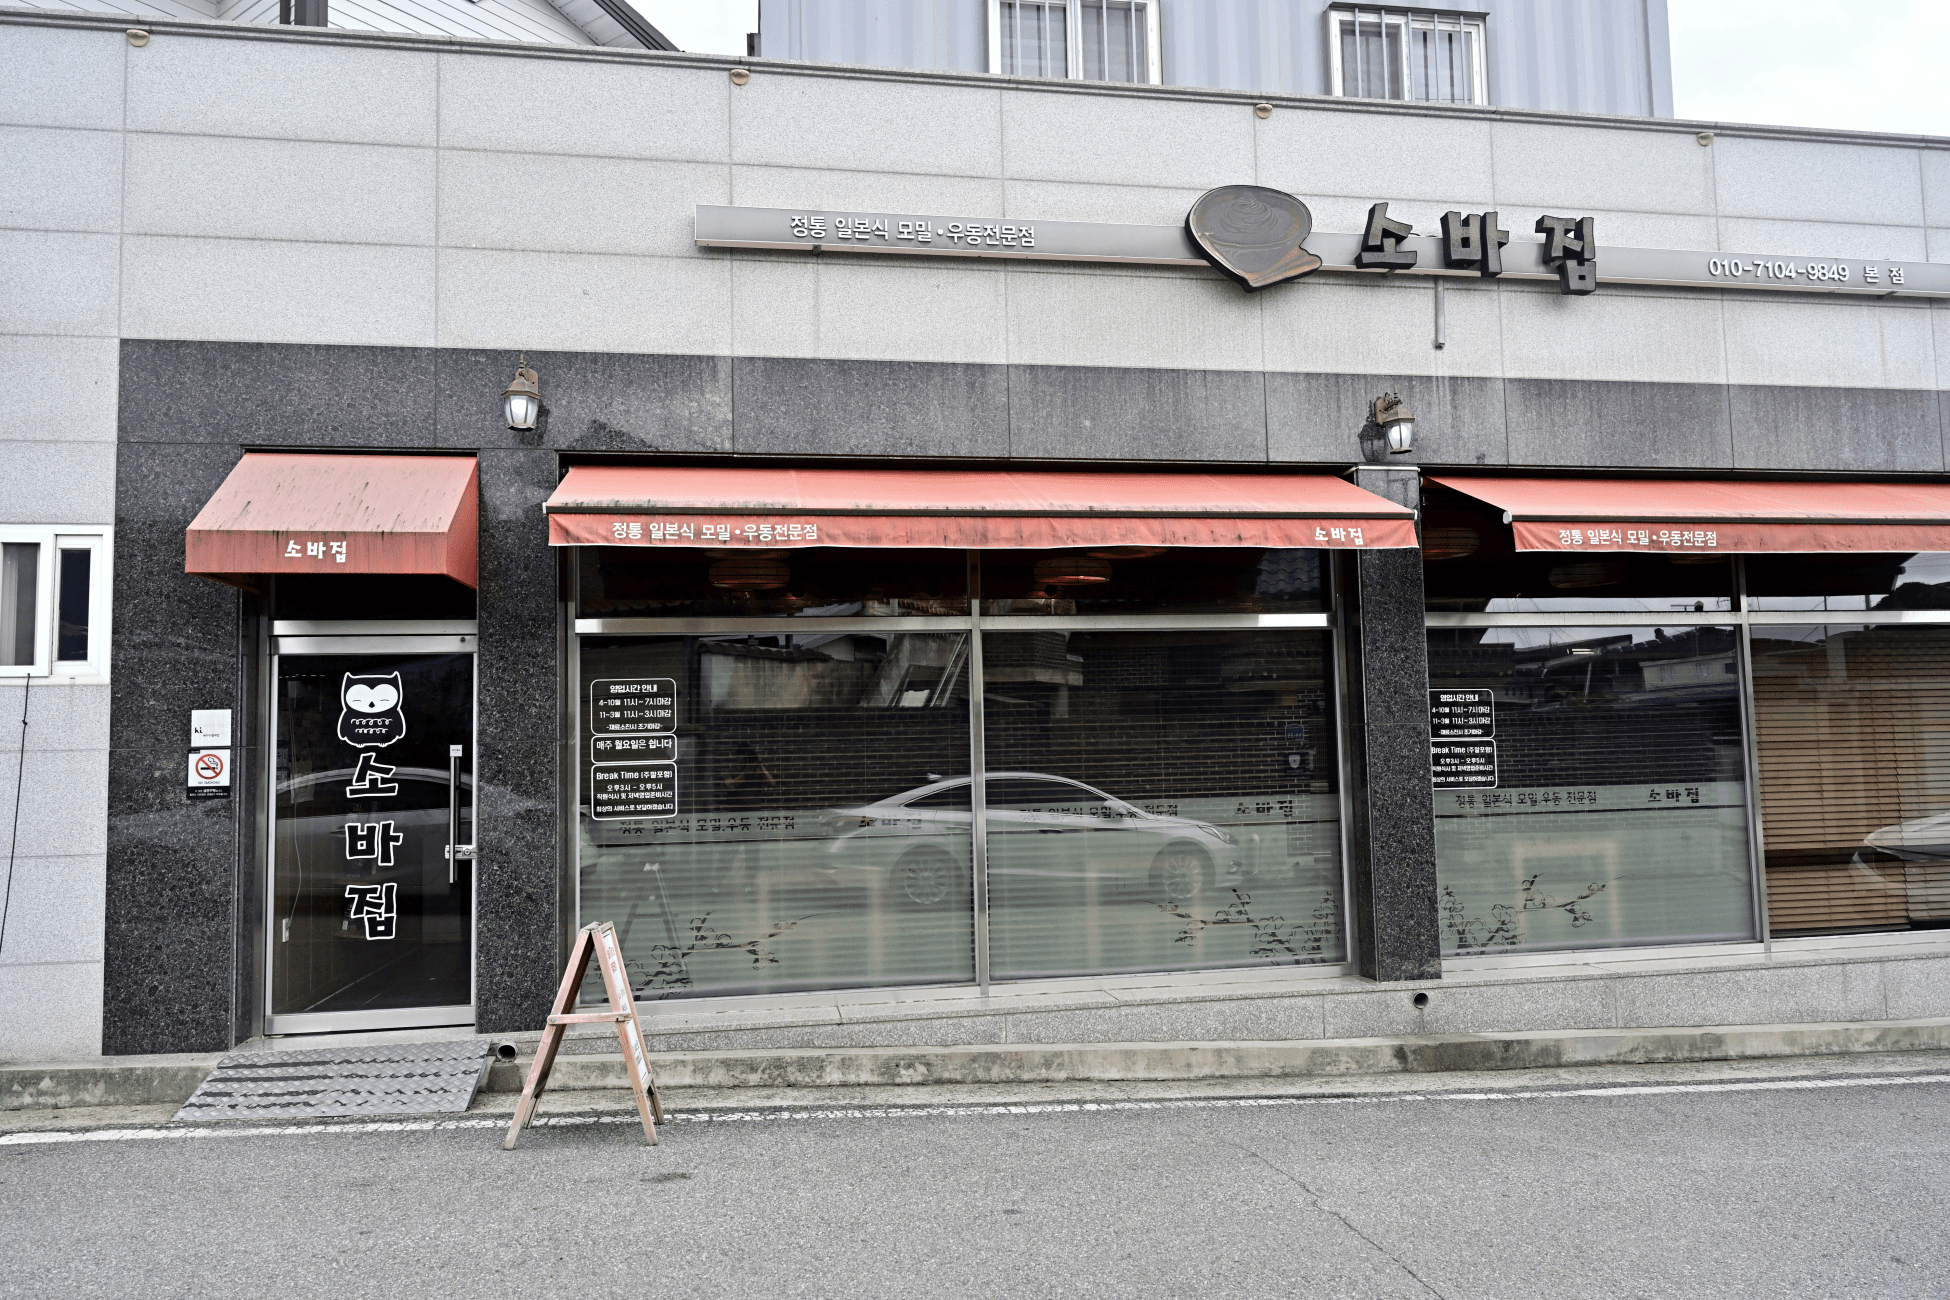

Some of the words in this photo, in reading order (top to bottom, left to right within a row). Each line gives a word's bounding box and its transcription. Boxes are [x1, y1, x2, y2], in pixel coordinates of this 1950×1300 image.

[791, 215, 827, 239] 정통
[835, 217, 889, 240] 일본식
[1354, 202, 1597, 296] 소바집
[1709, 257, 1849, 282] 010-7104-9849
[612, 522, 643, 540] 정통
[649, 522, 695, 540] 일본식
[1315, 526, 1364, 546] 소바집
[1559, 529, 1583, 545] 정통
[1587, 529, 1622, 545] 일본식
[284, 540, 347, 563] 소바집
[609, 684, 640, 694] 영업시간
[641, 684, 658, 693] 안내
[1440, 694, 1465, 702] 영업시간
[1465, 694, 1479, 702] 안내
[596, 740, 613, 751] 매주
[614, 739, 647, 750] 월요일은
[648, 738, 673, 749] 쉽니다
[1431, 746, 1450, 754] Break
[1450, 746, 1466, 754] Time
[596, 771, 619, 780] Break
[620, 771, 639, 779] Time
[641, 770, 673, 779] (주말포함)
[606, 784, 631, 792] 오후3시
[639, 783, 663, 791] 오후5시
[1648, 787, 1699, 804] 소바집
[596, 793, 620, 801] 직원식사
[1455, 795, 1476, 809] 정통
[1481, 793, 1512, 808] 일본식
[613, 804, 635, 812] 서비스로
[1235, 800, 1293, 818] 소바집
[345, 752, 403, 940] 소바집
